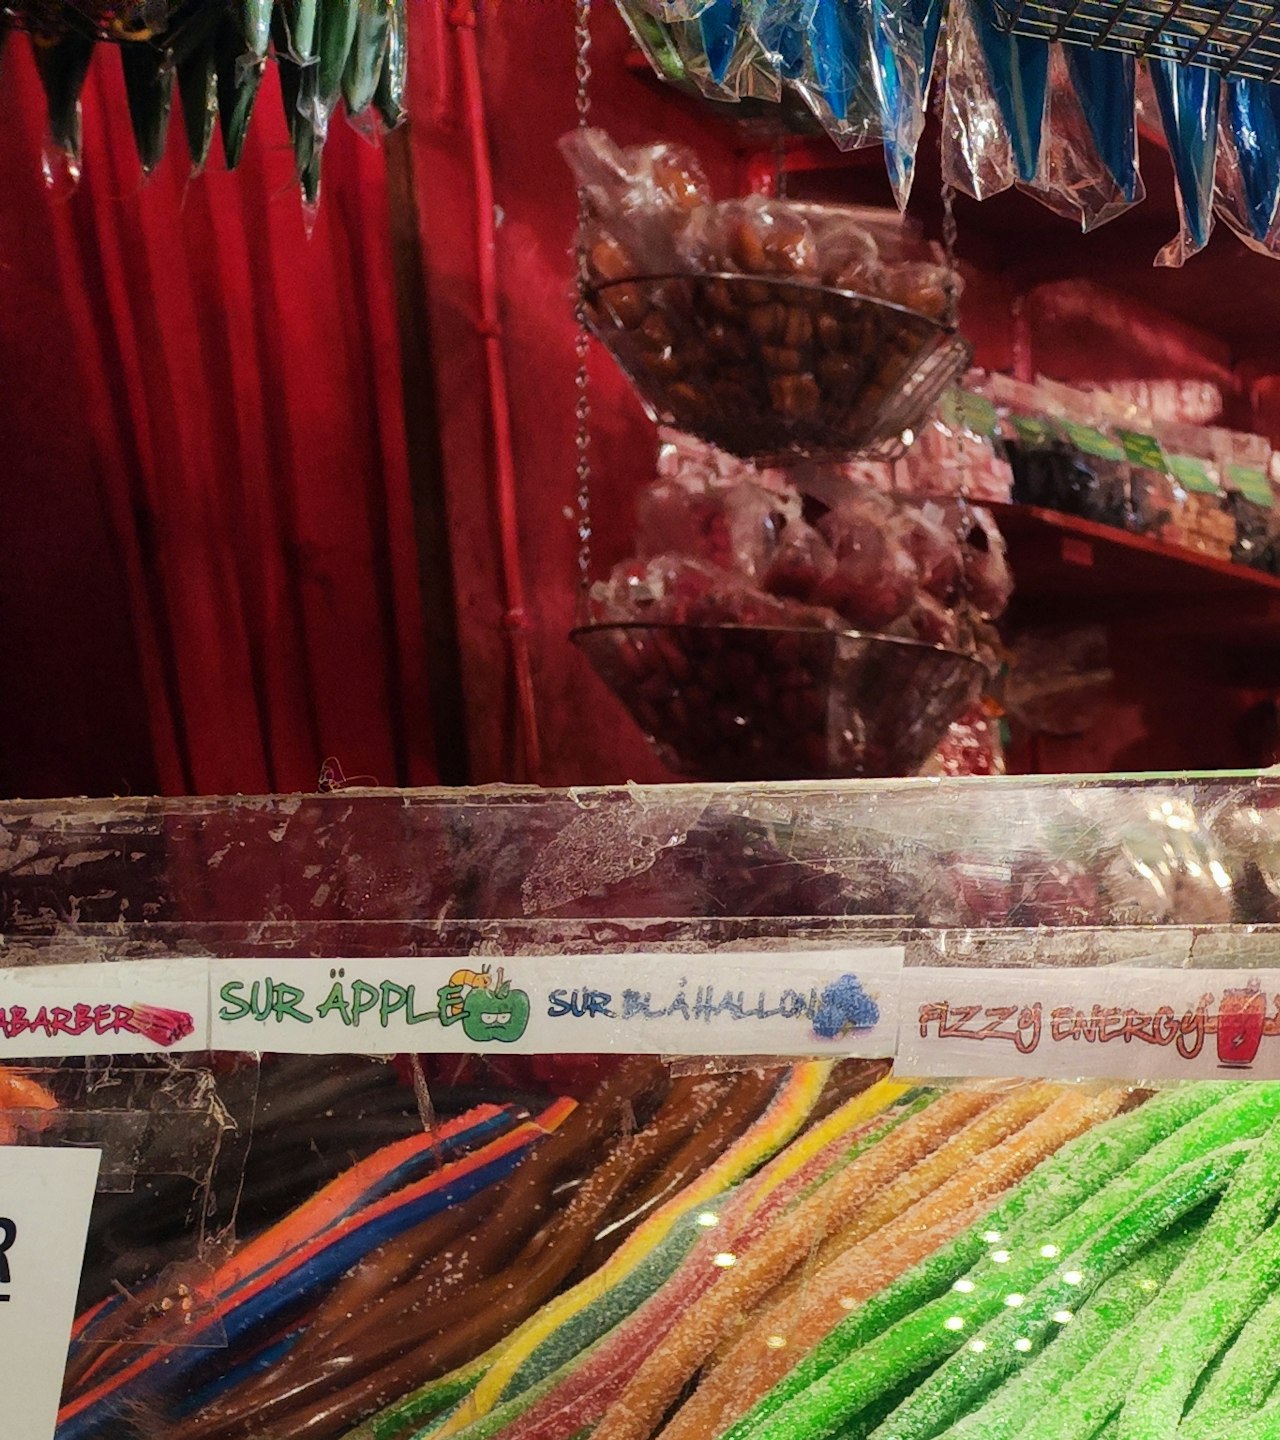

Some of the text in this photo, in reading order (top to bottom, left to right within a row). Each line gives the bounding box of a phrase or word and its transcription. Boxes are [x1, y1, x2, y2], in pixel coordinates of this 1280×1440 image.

[219, 968, 470, 1027] SUR ÄPPLE
[547, 985, 618, 1018] SUR
